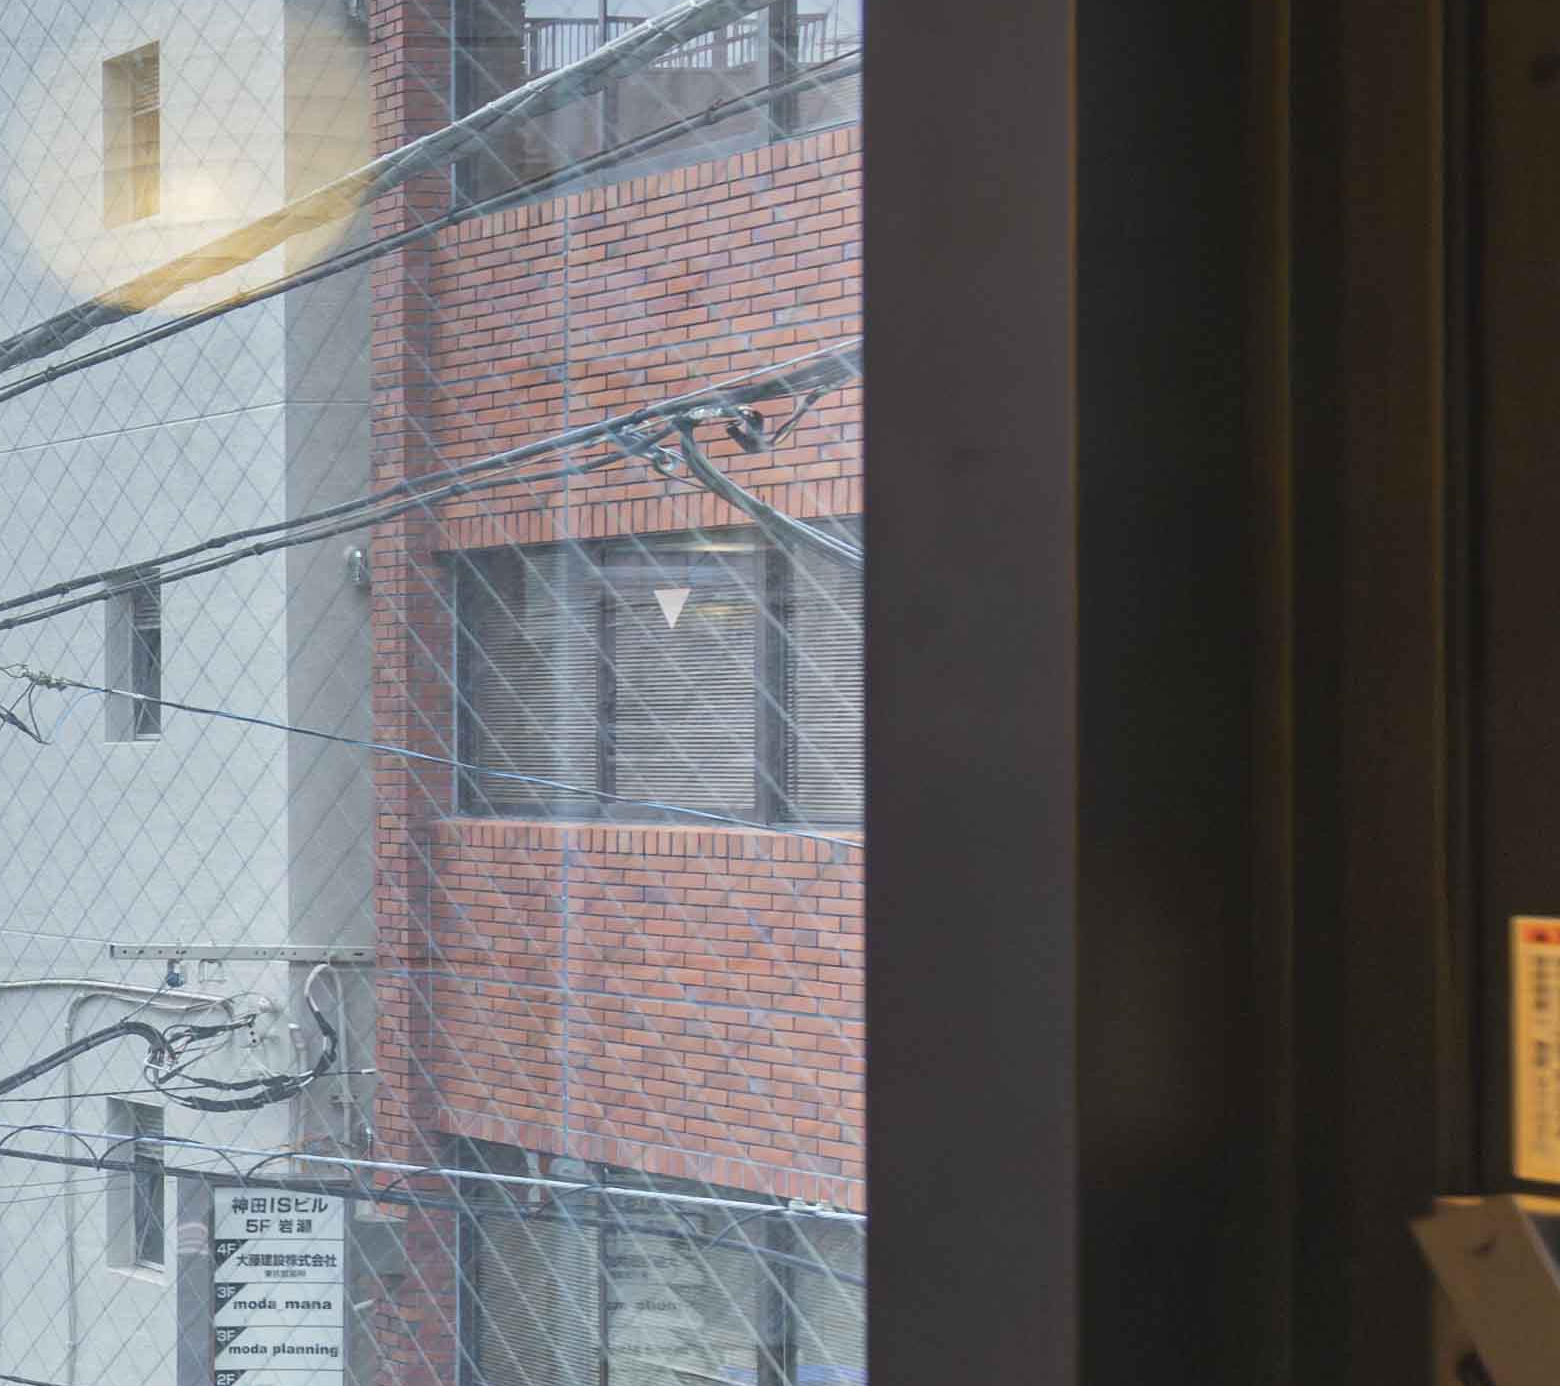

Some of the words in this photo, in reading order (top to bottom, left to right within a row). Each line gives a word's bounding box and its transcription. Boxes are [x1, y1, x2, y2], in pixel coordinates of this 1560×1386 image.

[231, 1196, 329, 1214] 神田ISビル
[245, 1219, 271, 1234] 5F
[217, 1244, 235, 1255] 4F
[217, 1286, 235, 1298] 3F
[233, 1298, 277, 1311] moda
[285, 1300, 333, 1311] mana
[217, 1330, 235, 1343] 3F
[228, 1344, 268, 1356] moda
[272, 1343, 339, 1358] planning
[217, 1374, 235, 1386] 2F
